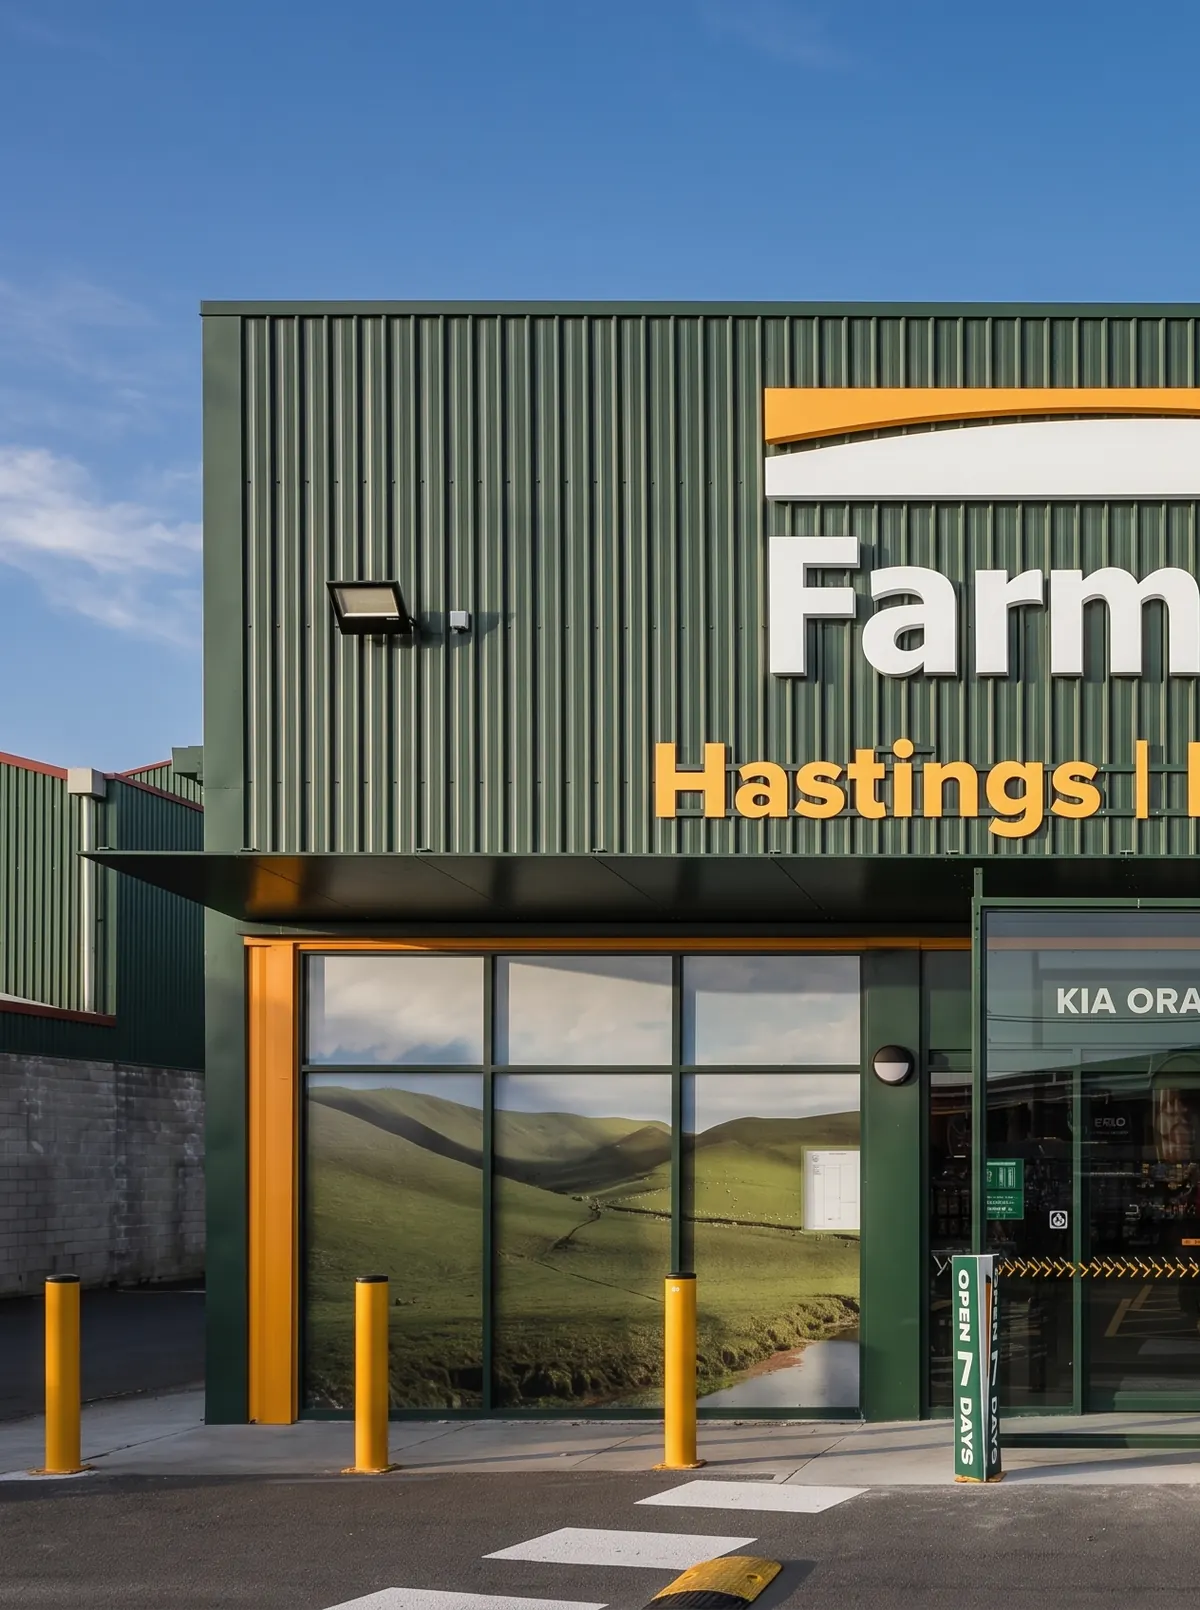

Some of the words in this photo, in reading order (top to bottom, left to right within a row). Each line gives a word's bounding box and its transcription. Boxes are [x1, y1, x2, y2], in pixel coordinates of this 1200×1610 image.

[655, 738, 1101, 838] Hastings
[1056, 987, 1117, 1014] KIA
[958, 1269, 971, 1342] OPEN
[957, 1350, 974, 1387] 7
[959, 1396, 974, 1466] DAYS
